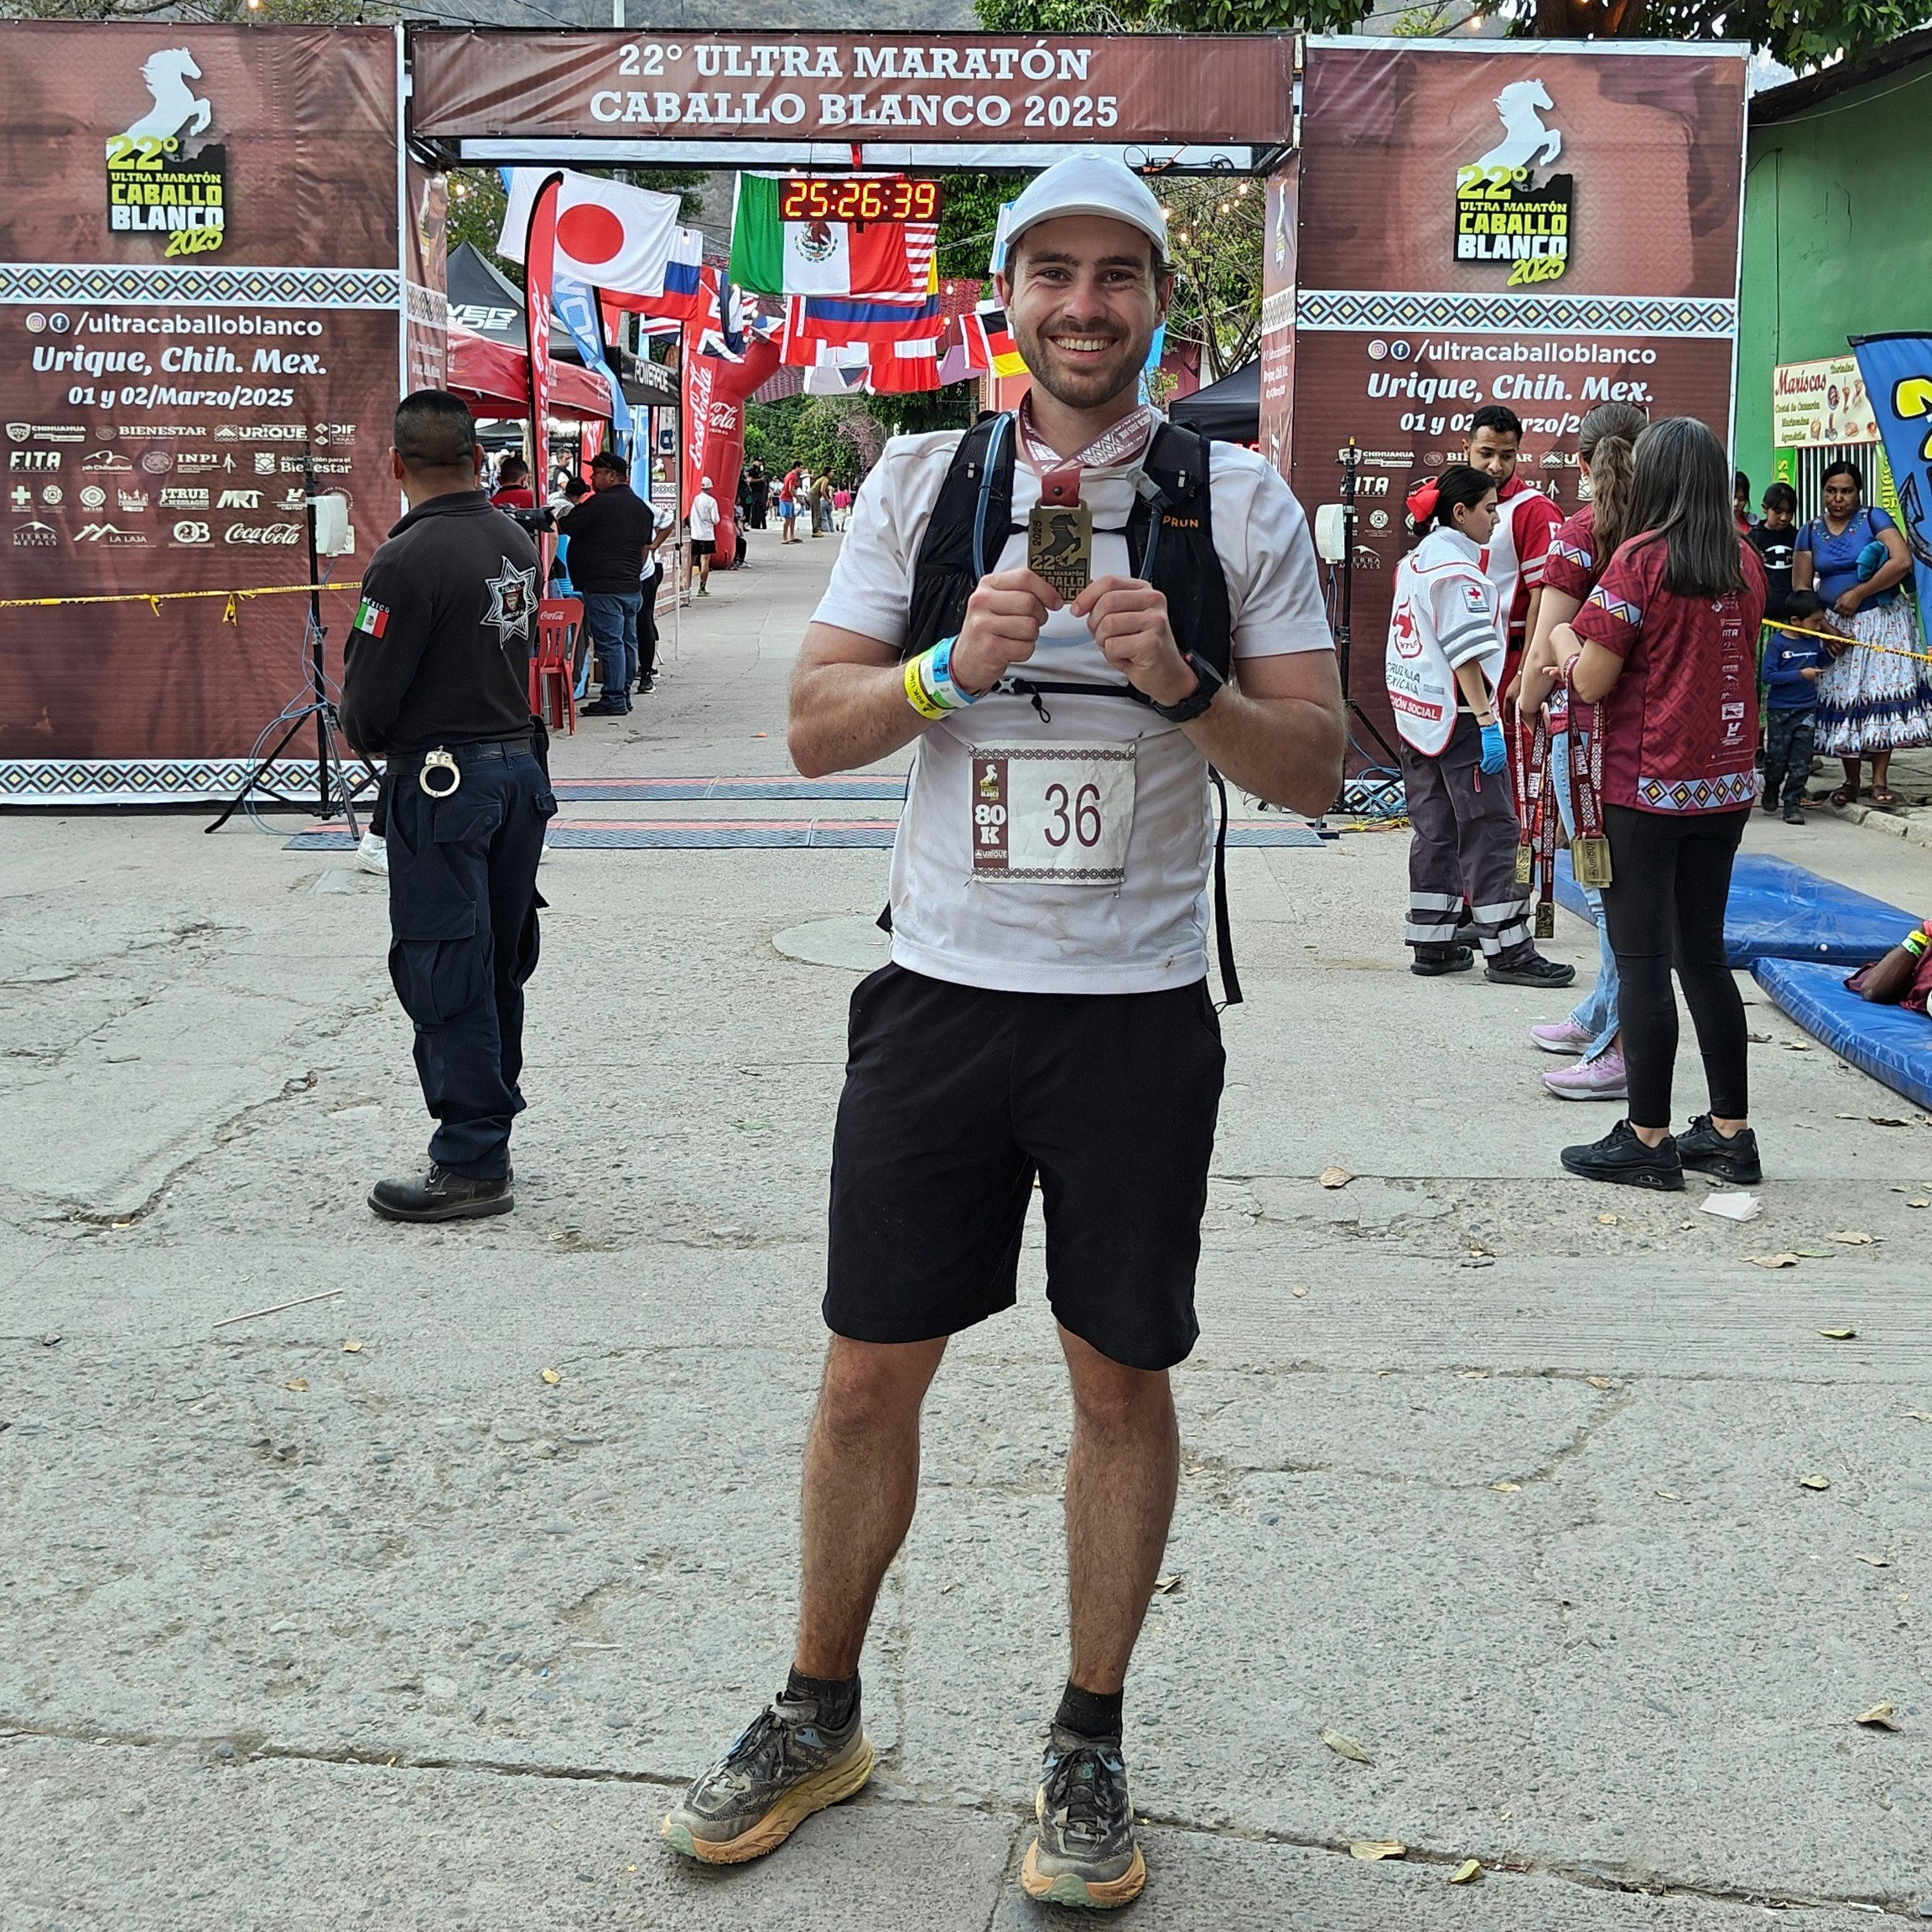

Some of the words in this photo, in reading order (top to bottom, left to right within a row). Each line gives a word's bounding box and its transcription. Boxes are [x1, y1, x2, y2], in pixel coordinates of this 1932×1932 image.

[619, 44, 683, 76] 22°
[694, 45, 842, 78] ULTRA
[854, 40, 1092, 80] MARATÓN
[589, 91, 807, 124] CABALLO
[818, 94, 1011, 127] BLANCO
[1024, 95, 1119, 127] 2025
[107, 135, 179, 170] 22°
[111, 172, 153, 184] ULTRA
[155, 170, 221, 184] MARATÓN
[1457, 166, 1527, 200] 22°
[112, 184, 223, 206] CABALLO
[784, 180, 936, 219] 25:26:39
[1459, 201, 1500, 213] ULTRA
[1504, 200, 1567, 213] MARATÓN
[111, 205, 225, 231] BLANCO
[1459, 212, 1567, 236] CABALLO
[164, 225, 224, 257] 2025
[1458, 234, 1568, 260] BLANCO
[1506, 255, 1566, 287] 2025
[74, 311, 323, 335] /ultracaballoblanco
[32, 345, 153, 377] Urique,
[160, 345, 244, 374] Chih.
[252, 348, 328, 375] Mex.
[1414, 339, 1657, 365] /ultracaballoblanco
[1367, 371, 1483, 404] Urique,
[1491, 373, 1573, 402] Chih.
[1581, 376, 1654, 403] Mex.
[1774, 368, 1826, 397] Mariscos
[68, 387, 95, 405] 01
[100, 389, 117, 409] y
[120, 384, 294, 409] 02/Marzo/2025
[119, 426, 207, 436] BIENESTAR
[330, 424, 356, 434] DIF
[1400, 413, 1427, 431] 01
[1430, 415, 1447, 436] y
[10, 451, 61, 467] FITA
[178, 454, 218, 463] INPI
[281, 461, 352, 473] Bieestar
[169, 488, 210, 499] TRUE
[1340, 476, 1389, 492] ITA
[225, 522, 304, 544] Coca-Cola
[1032, 520, 1042, 546] 2025
[361, 595, 391, 615] MÉXICO
[1407, 702, 1437, 719] SOCIAL
[974, 804, 1006, 826] 80
[1043, 783, 1102, 849] 36
[980, 826, 1000, 844] K
